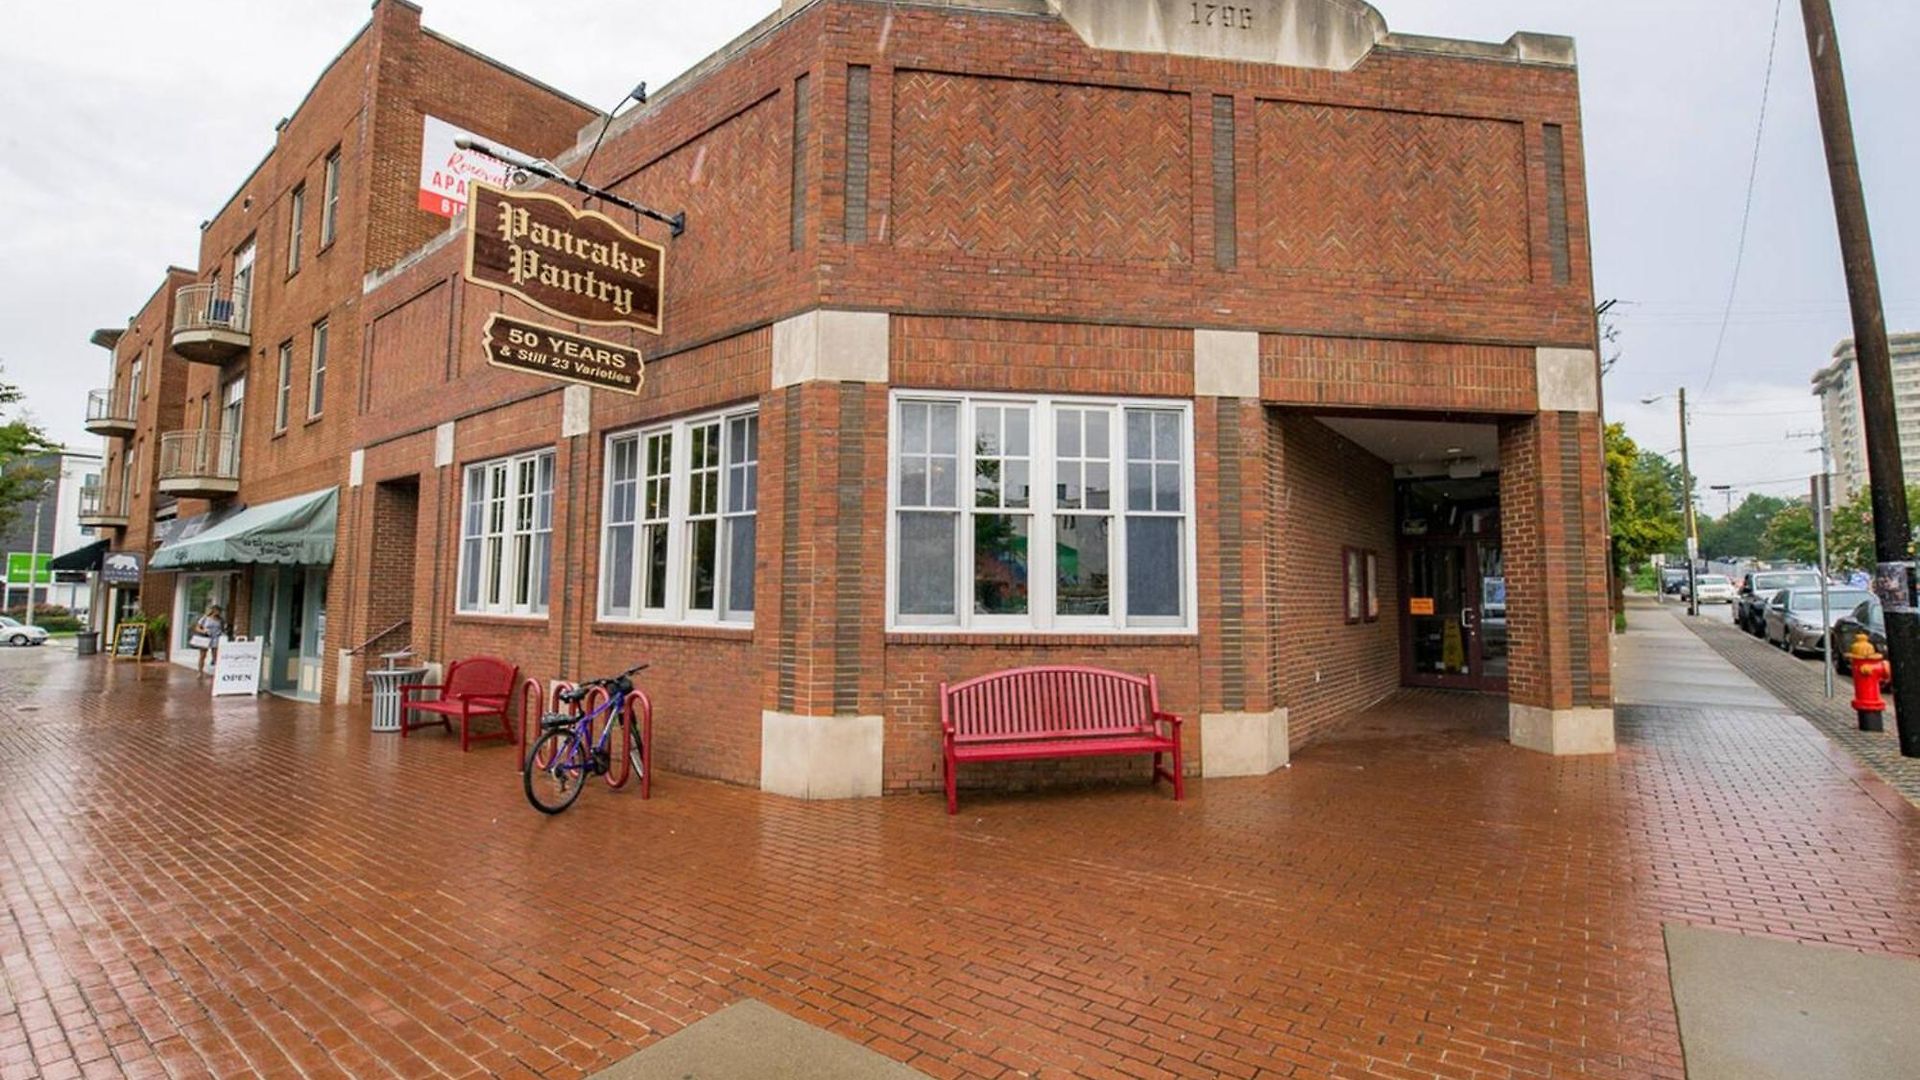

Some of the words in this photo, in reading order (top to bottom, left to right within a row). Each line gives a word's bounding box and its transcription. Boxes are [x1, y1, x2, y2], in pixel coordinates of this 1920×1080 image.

[432, 171, 466, 197] APA
[498, 202, 646, 278] Pancake
[508, 245, 634, 315] Pantry
[499, 345, 511, 357] &
[517, 349, 547, 365] Still
[552, 357, 570, 370] 23
[574, 361, 632, 384] Varieties
[508, 328, 539, 348] 50
[548, 336, 627, 369] YEARS
[222, 673, 252, 682] OPEN
